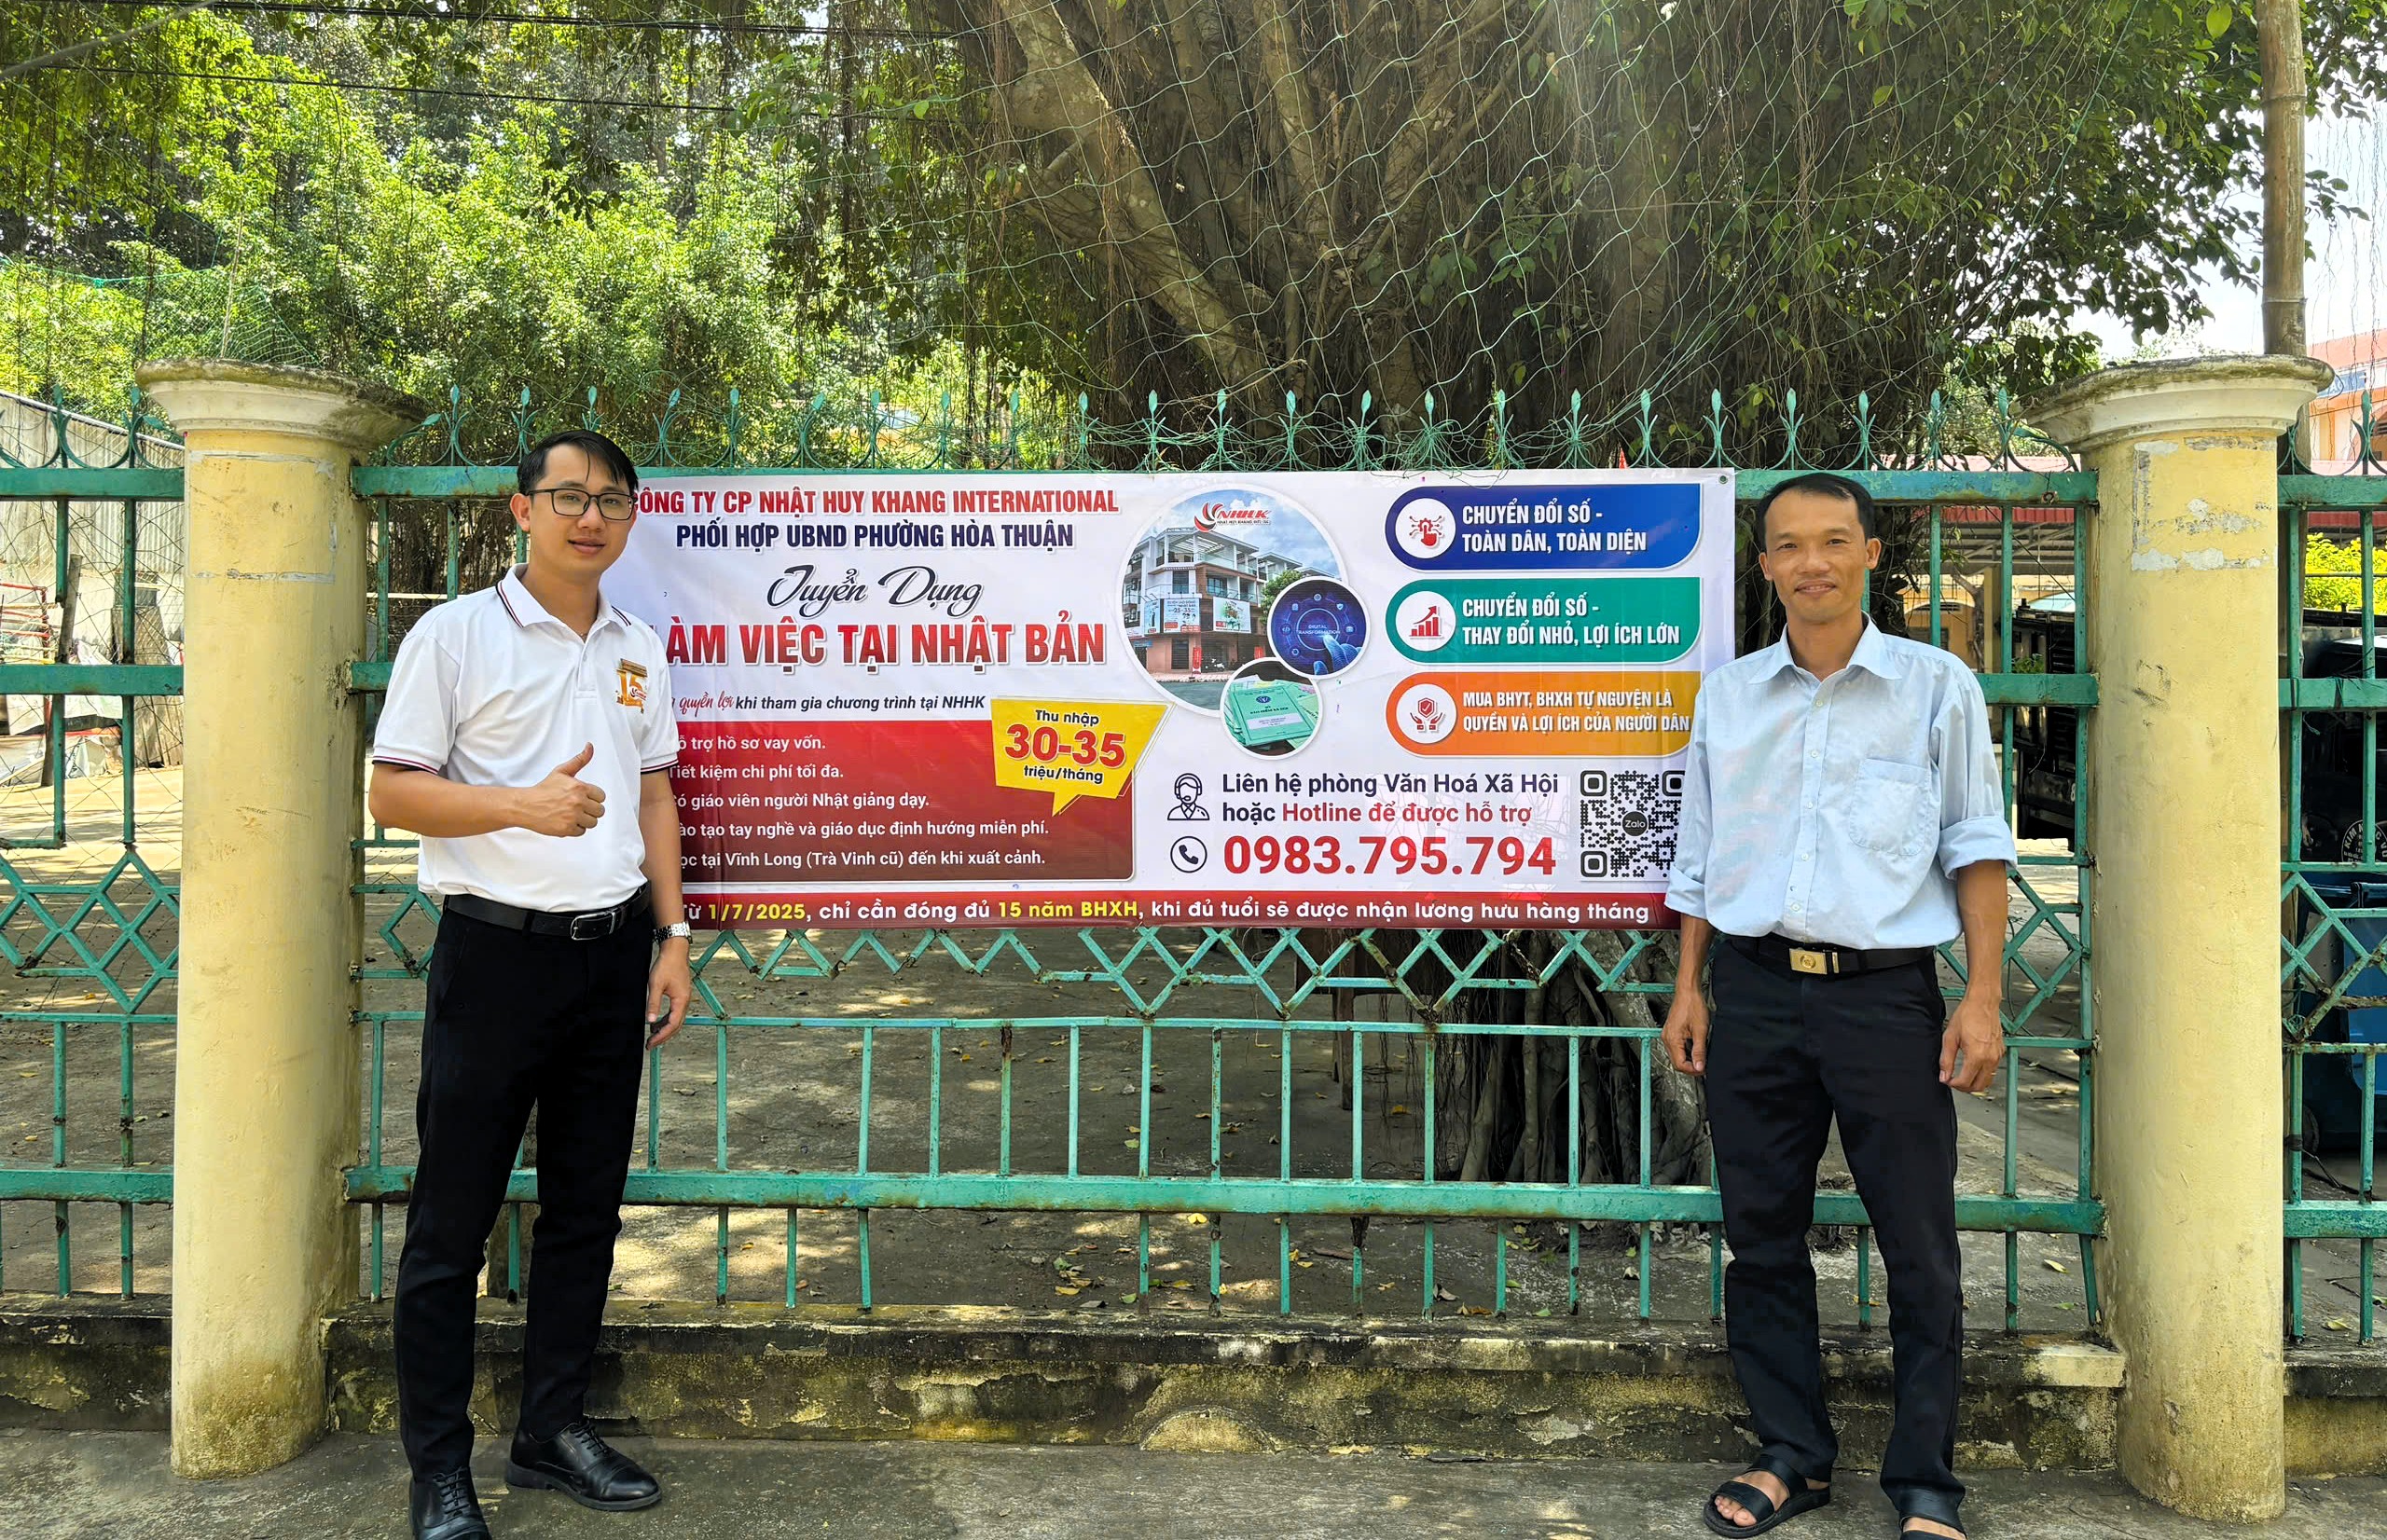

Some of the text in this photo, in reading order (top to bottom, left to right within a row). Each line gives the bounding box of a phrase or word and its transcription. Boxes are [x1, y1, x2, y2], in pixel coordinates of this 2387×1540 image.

[634, 487, 1118, 517] ÔNG TY CP NHẬT HUY KHANG INTERNATIONAL
[1463, 498, 1528, 524] CHUYỂN
[1534, 498, 1562, 523] ĐỔI
[1568, 499, 1590, 523] SỐ
[677, 517, 1072, 552] PHỐI HỢP UBND PHƯỜNG HÒA THUẬN
[1462, 529, 1646, 554] TOÀN DÂN, TOÀN DIỆN
[878, 566, 983, 617] Dụng
[1463, 592, 1526, 616] CHUYỂN
[1532, 592, 1559, 616] ĐỔI
[1566, 592, 1586, 616] SỐ
[654, 611, 1103, 672] ÀM VIỆC TẠI NHẬT BẢN
[1463, 620, 1678, 647] THAY ĐỔI NHỎ, LỢI ÍCH LỚN
[680, 692, 713, 717] quyền
[718, 691, 734, 710] lợi
[736, 696, 757, 708] khi
[762, 696, 796, 708] tham
[801, 696, 821, 711] gia
[827, 696, 879, 711] chương
[884, 696, 916, 708] trình
[920, 696, 938, 710] tại
[943, 696, 986, 708] NHHK
[1463, 689, 1672, 708] MUA BHYT, BHXH TỰ NGUYỆN LÀ
[1035, 709, 1099, 726] Thu nhập
[1464, 711, 1689, 734] QUYỀN VÀ LỢI ÍCH CỦA NGƯỜI DÂN
[679, 735, 825, 752] ỗ trợ hồ sơ vay vốn.
[1005, 723, 1126, 768] 30-35
[701, 765, 737, 780] kiệm
[742, 764, 764, 777] chi
[769, 764, 793, 781] phí
[797, 763, 816, 777] tối
[821, 764, 843, 777] đa.
[1024, 765, 1103, 784] triệu/tháng
[1223, 773, 1557, 797] Liên hệ phòng Văn Hoá Xã Hội
[675, 791, 929, 810] ó giáo viên người Nhật giảng dạy.
[1223, 801, 1532, 826] hoặc Hotline để được hỗ trợ
[680, 819, 1048, 839] ào tạo tay nghề và giáo dục định hướng miễn phí.
[681, 849, 1044, 869] ọc tại Vĩnh Long (Trà Vinh cũ) đến khi xuất cảnh.
[1224, 836, 1556, 874] 0983.795.794
[709, 904, 811, 922] 1/7/2025,
[820, 901, 850, 919] chỉ
[858, 899, 896, 918] cần
[904, 901, 956, 923] đóng
[964, 901, 989, 918] đủ
[1000, 902, 1021, 917] 15
[1029, 901, 1073, 917] năm
[1082, 901, 1143, 918] BHXH,
[1152, 901, 1180, 916] khi
[1189, 899, 1213, 916] đủ
[1221, 896, 1259, 916] tuổi
[1267, 901, 1289, 917] sẽ
[1297, 902, 1348, 921] được
[1357, 901, 1407, 922] nhận
[1415, 902, 1472, 922] lương
[1482, 903, 1518, 918] hưu
[1527, 902, 1580, 923] hàng
[1588, 902, 1648, 923] tháng
